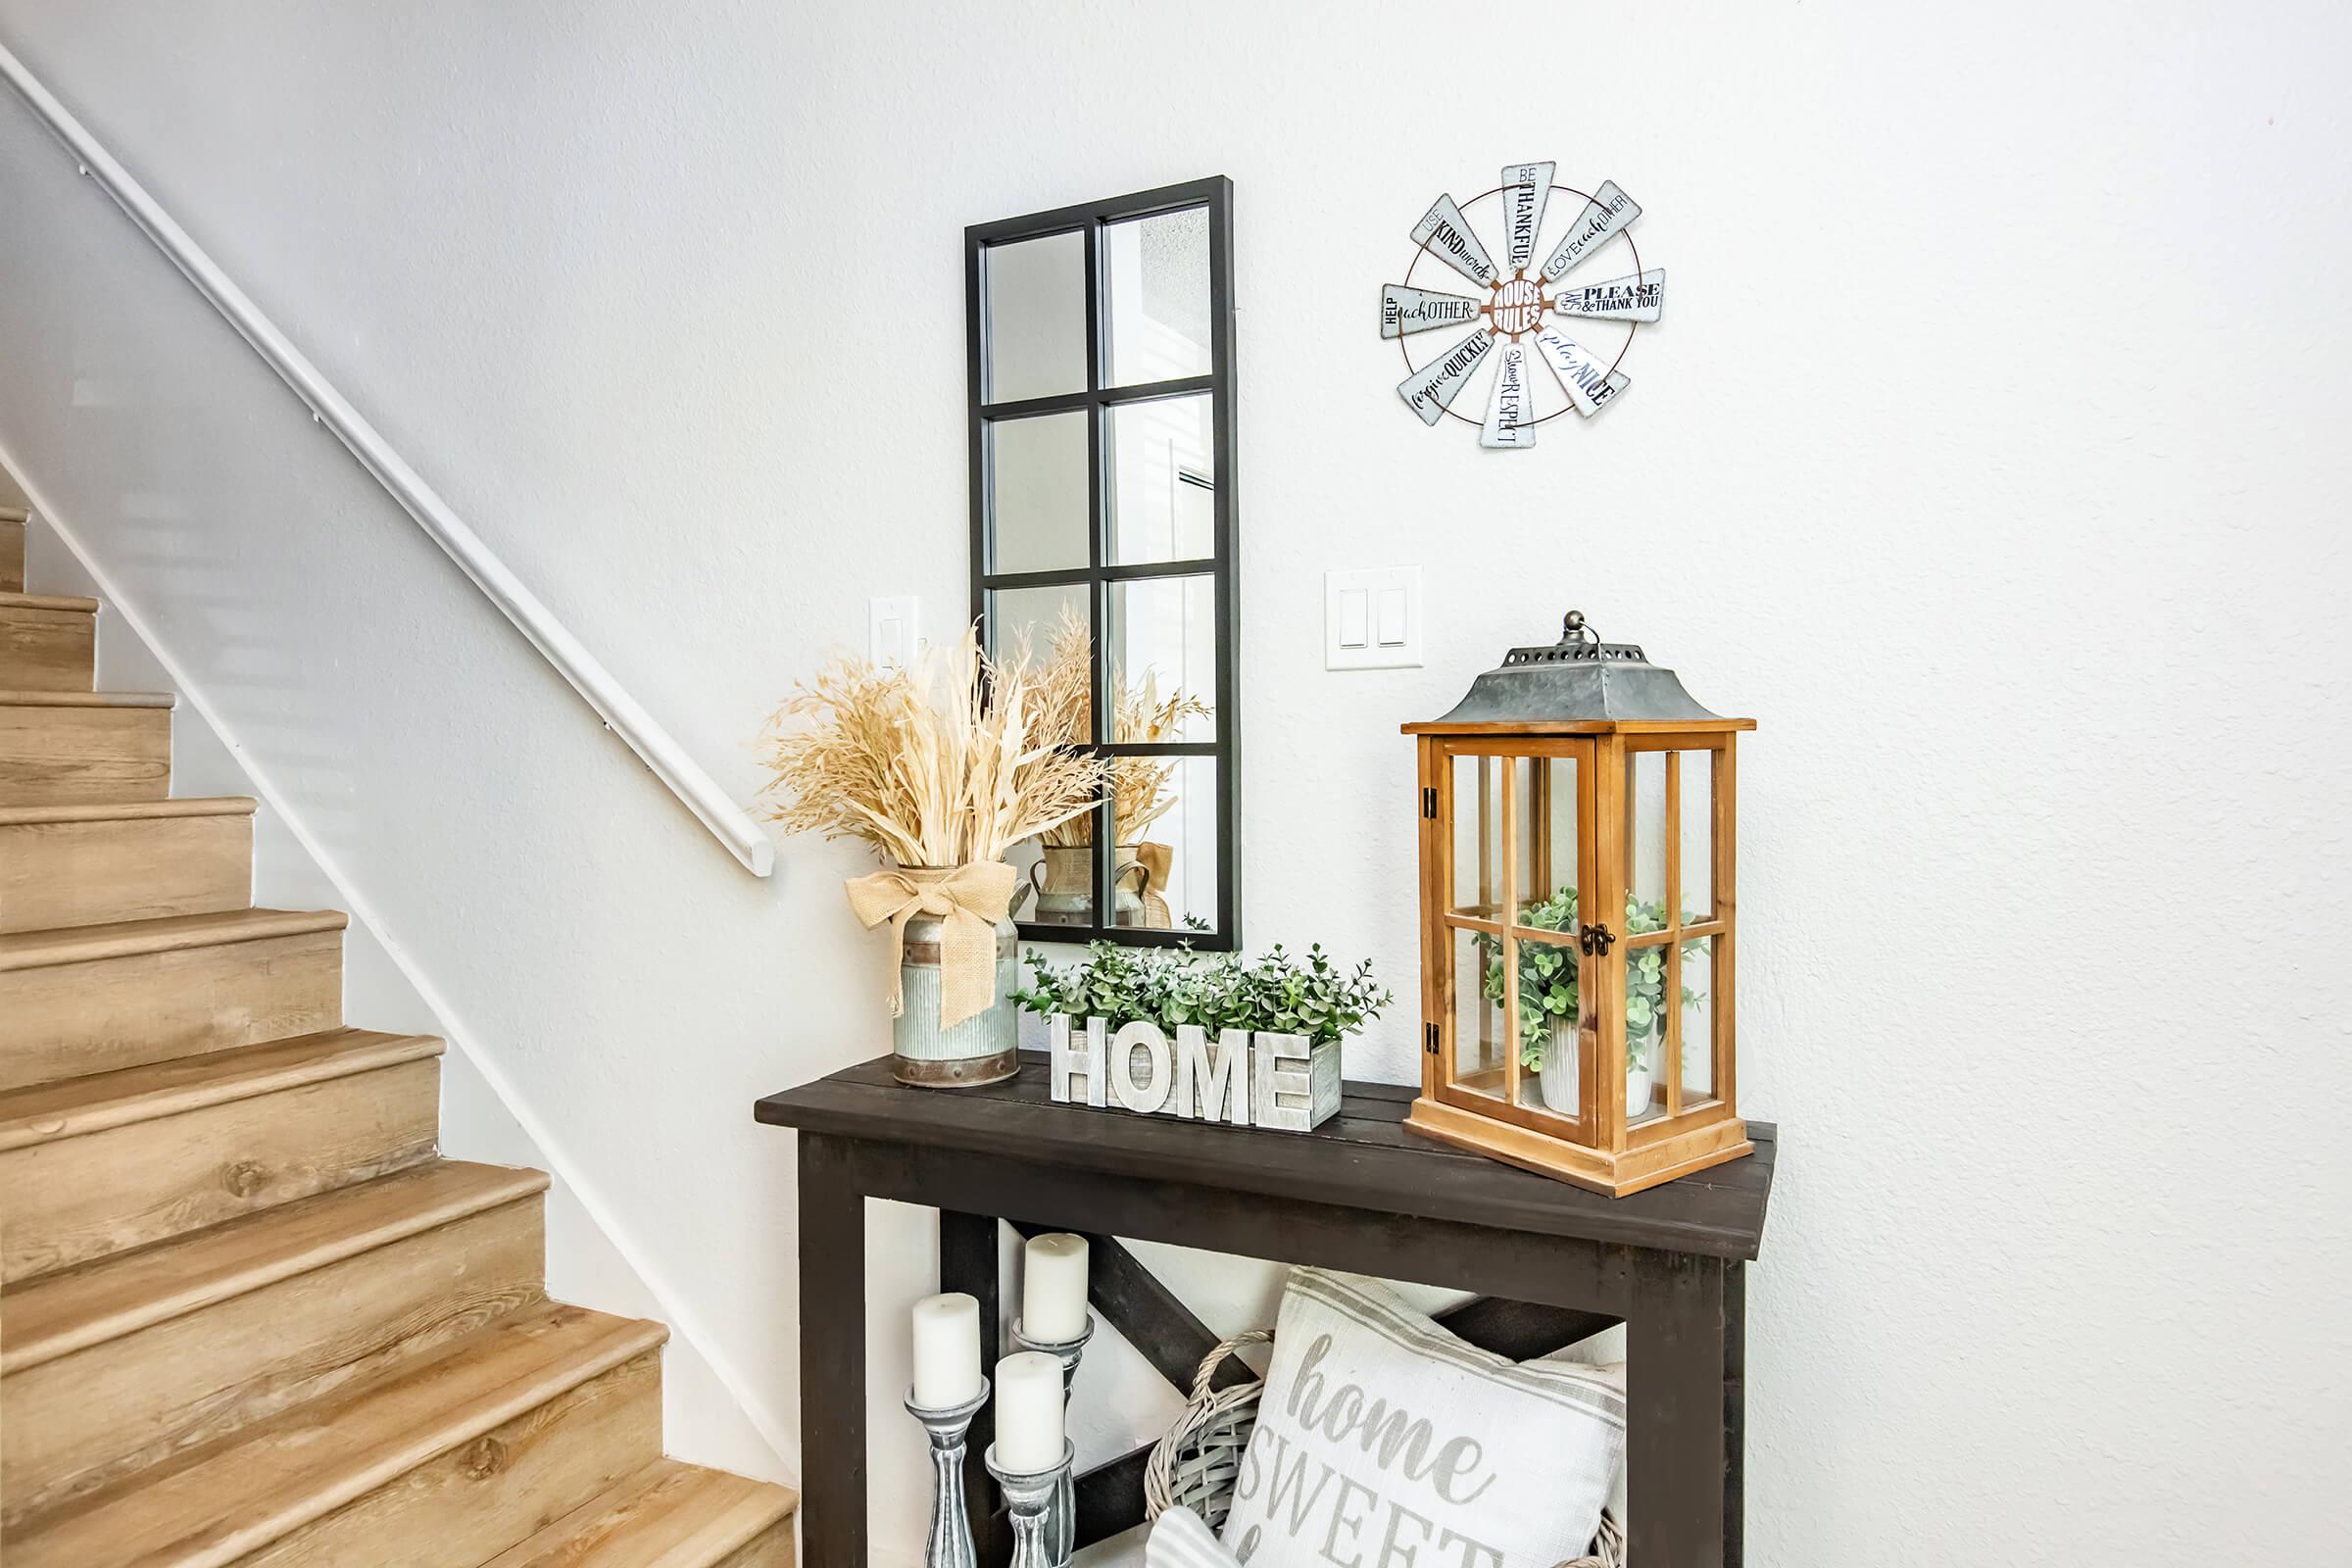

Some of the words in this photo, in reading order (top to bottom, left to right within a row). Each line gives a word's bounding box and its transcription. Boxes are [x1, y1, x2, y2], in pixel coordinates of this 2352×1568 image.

[1519, 168, 1537, 183] BE
[1422, 209, 1444, 232] USE
[1511, 182, 1537, 265] THANKFUL
[1435, 220, 1465, 255] KIND
[1460, 249, 1490, 279] words
[1547, 241, 1582, 275] LOVE
[1577, 218, 1607, 247] each
[1385, 297, 1397, 324] HELP
[1427, 301, 1472, 320] OTHER
[1494, 279, 1541, 307] HOUSE
[1560, 294, 1583, 311] SAY
[1584, 282, 1660, 300] PLEASE
[1637, 295, 1659, 309] YOU
[1494, 304, 1541, 333] RULES
[1444, 331, 1490, 378] QUICKLY
[1571, 363, 1616, 407] NICE
[1497, 383, 1521, 444] RESPECT
[1051, 1012, 1313, 1133] HOME
[1287, 1333, 1496, 1505] home
